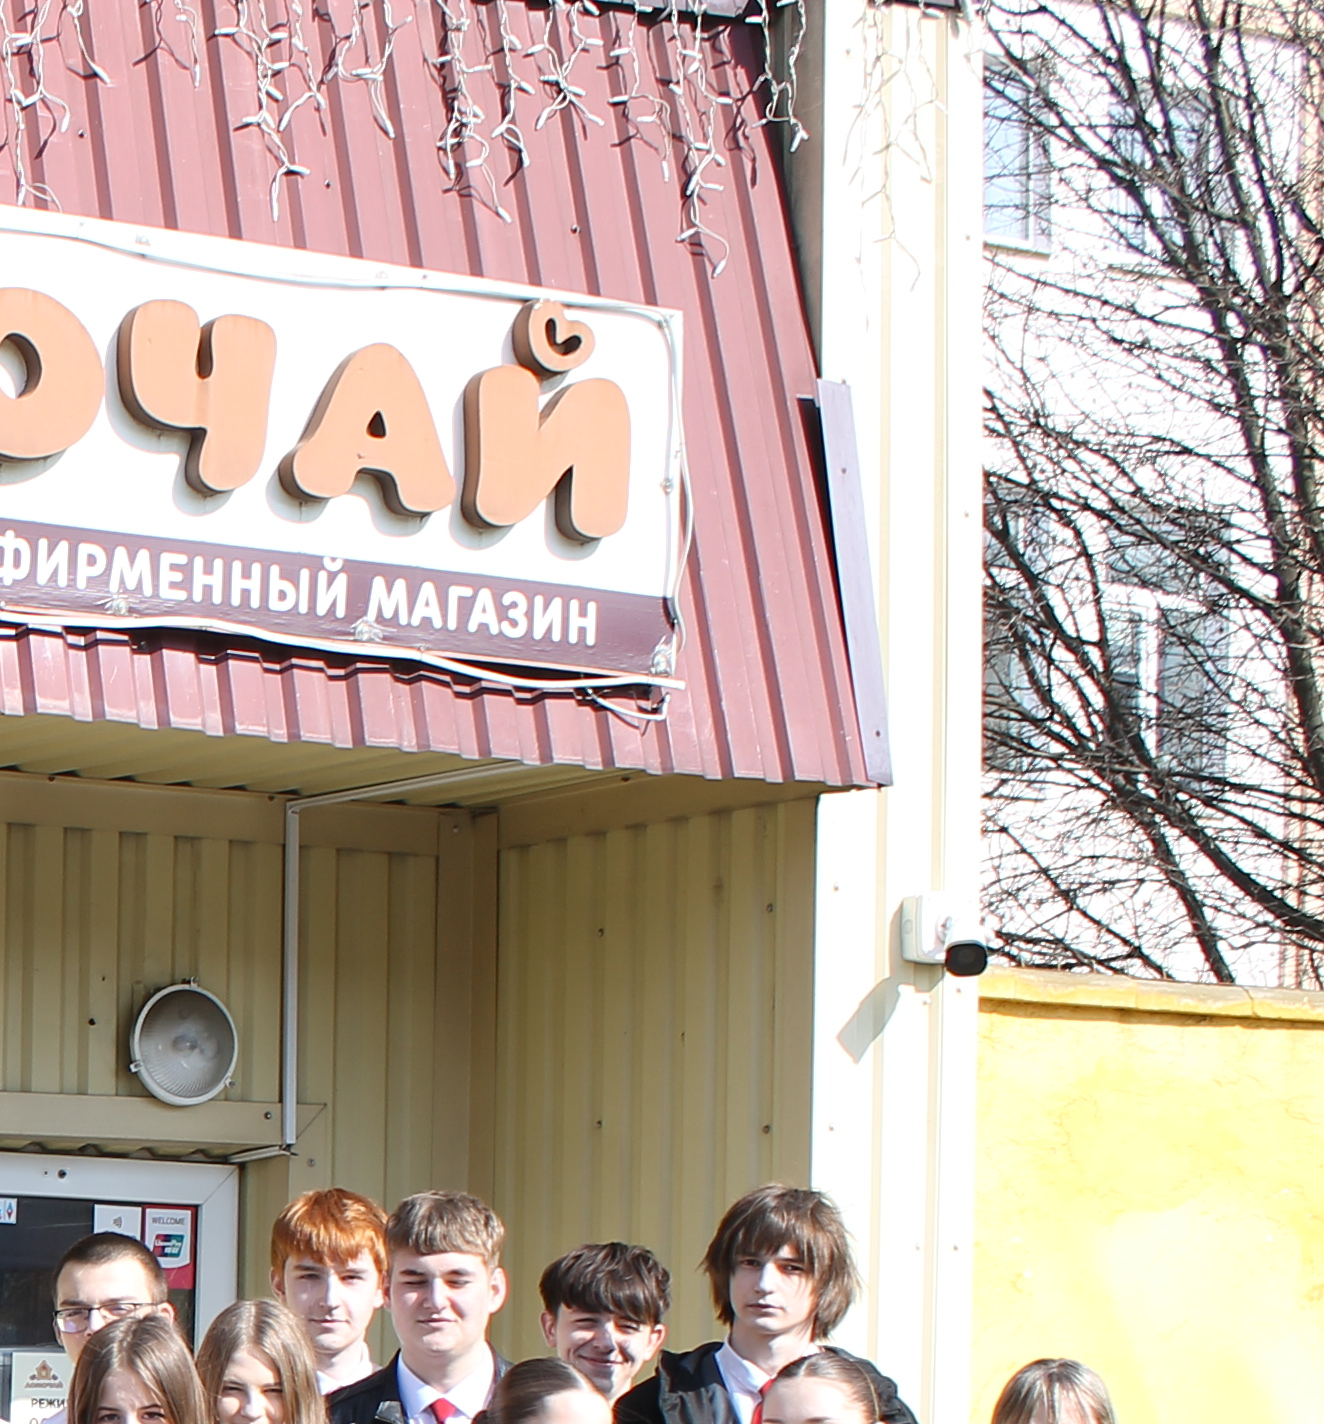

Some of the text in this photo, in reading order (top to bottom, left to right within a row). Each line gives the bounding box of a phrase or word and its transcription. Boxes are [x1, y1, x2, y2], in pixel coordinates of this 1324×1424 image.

[367, 576, 598, 647] МАГАЗИН
[151, 1216, 186, 1225] WELCOME
[31, 1398, 66, 1408] РЕЖИ
